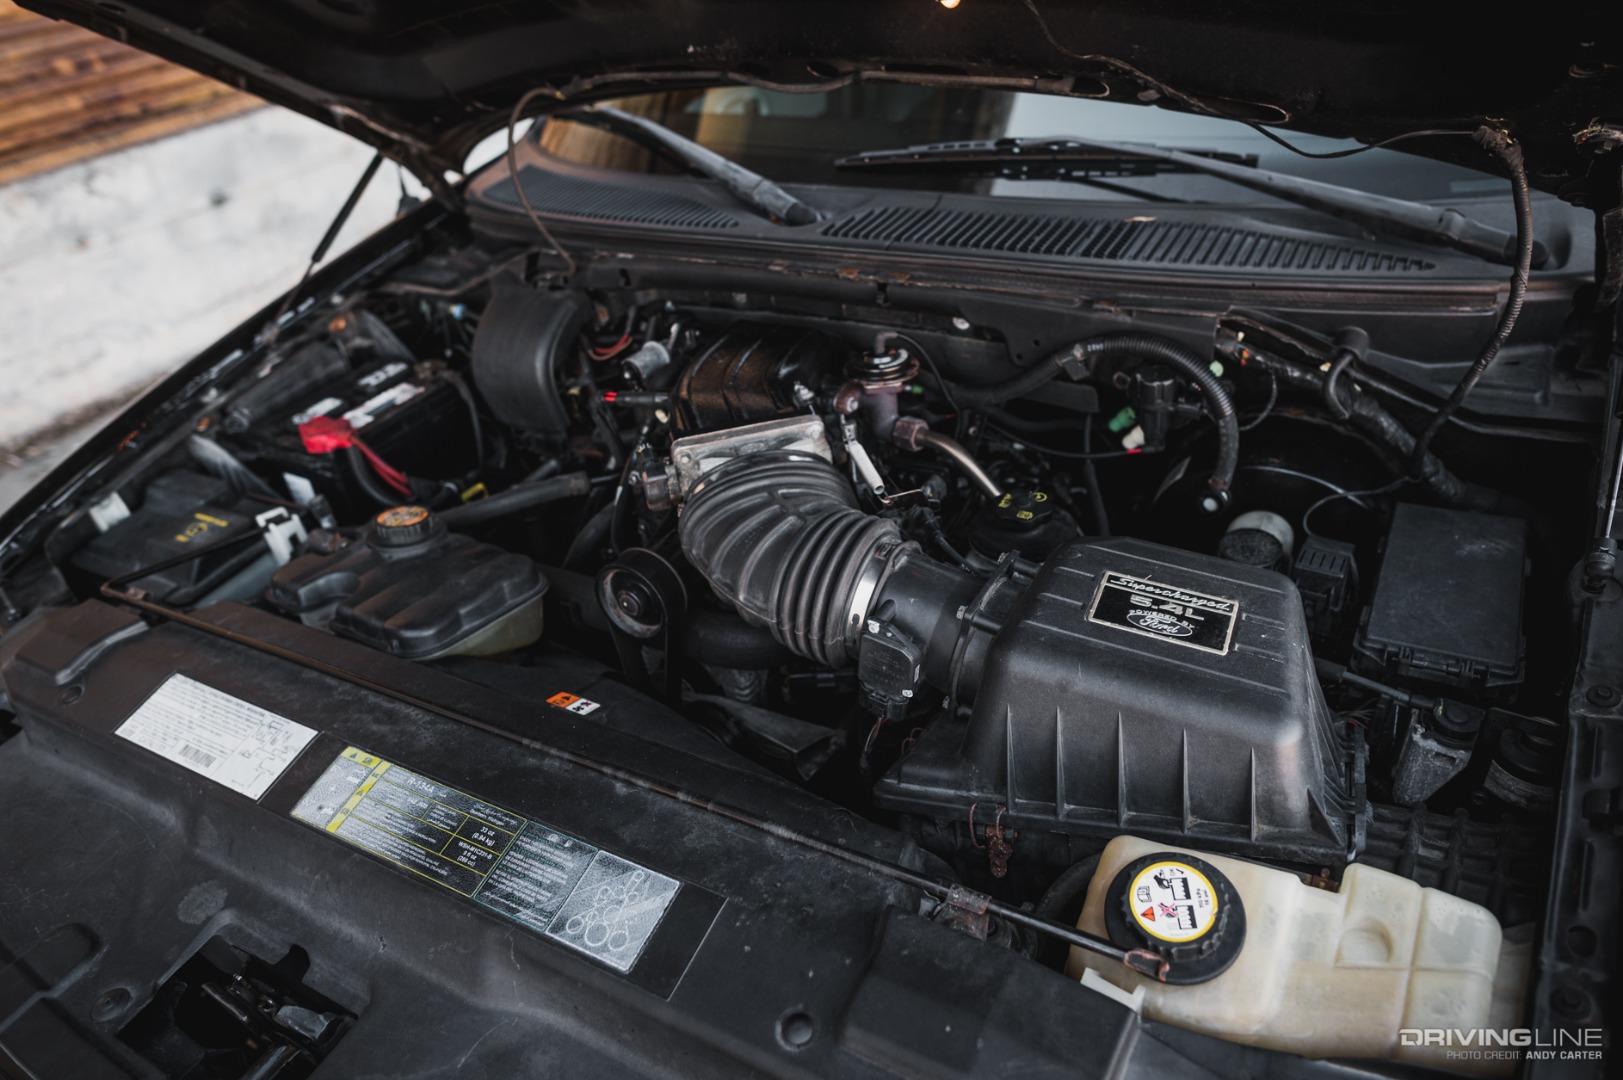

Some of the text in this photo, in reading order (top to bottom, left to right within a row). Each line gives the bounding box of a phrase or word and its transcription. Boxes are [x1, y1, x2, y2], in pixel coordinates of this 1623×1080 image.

[1110, 577, 1230, 611] Supercharged
[1130, 594, 1204, 620] 5.4L
[1129, 609, 1195, 629] POWERED BY
[1139, 614, 1180, 633] Ford
